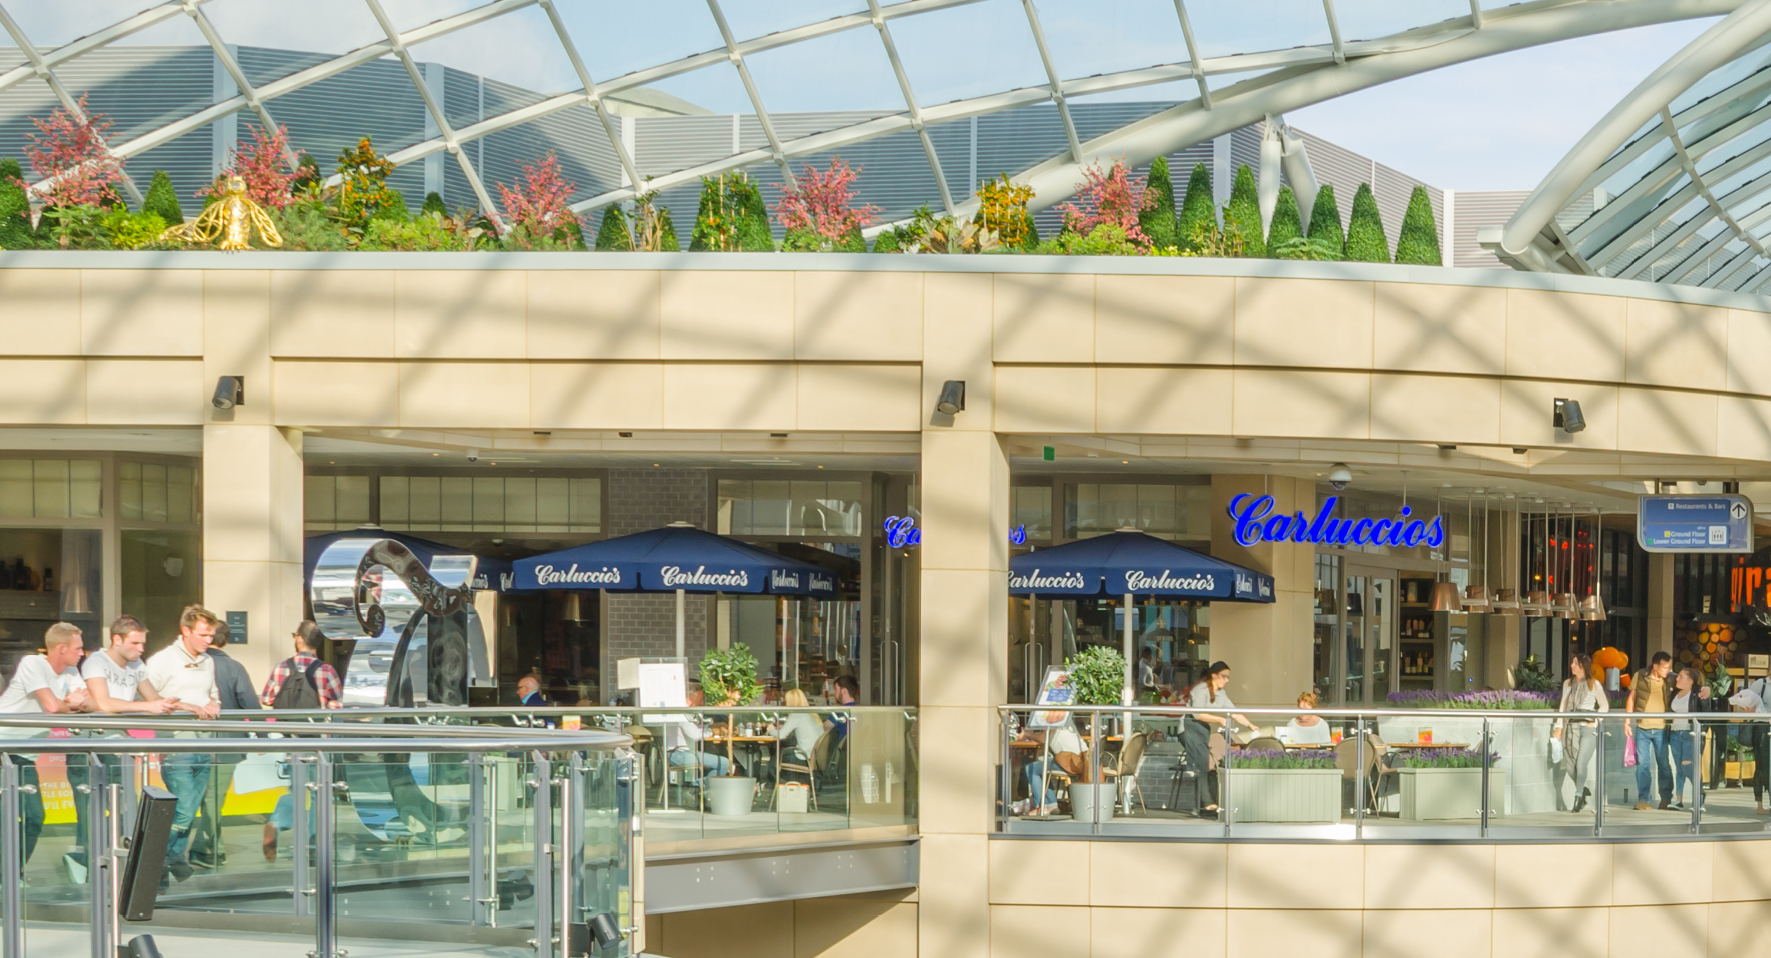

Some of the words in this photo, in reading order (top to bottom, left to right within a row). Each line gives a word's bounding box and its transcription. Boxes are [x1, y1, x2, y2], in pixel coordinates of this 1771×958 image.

[535, 563, 621, 585] Carluccio's
[661, 565, 748, 587] Carluccio's
[1126, 570, 1216, 591] Carluccio's
